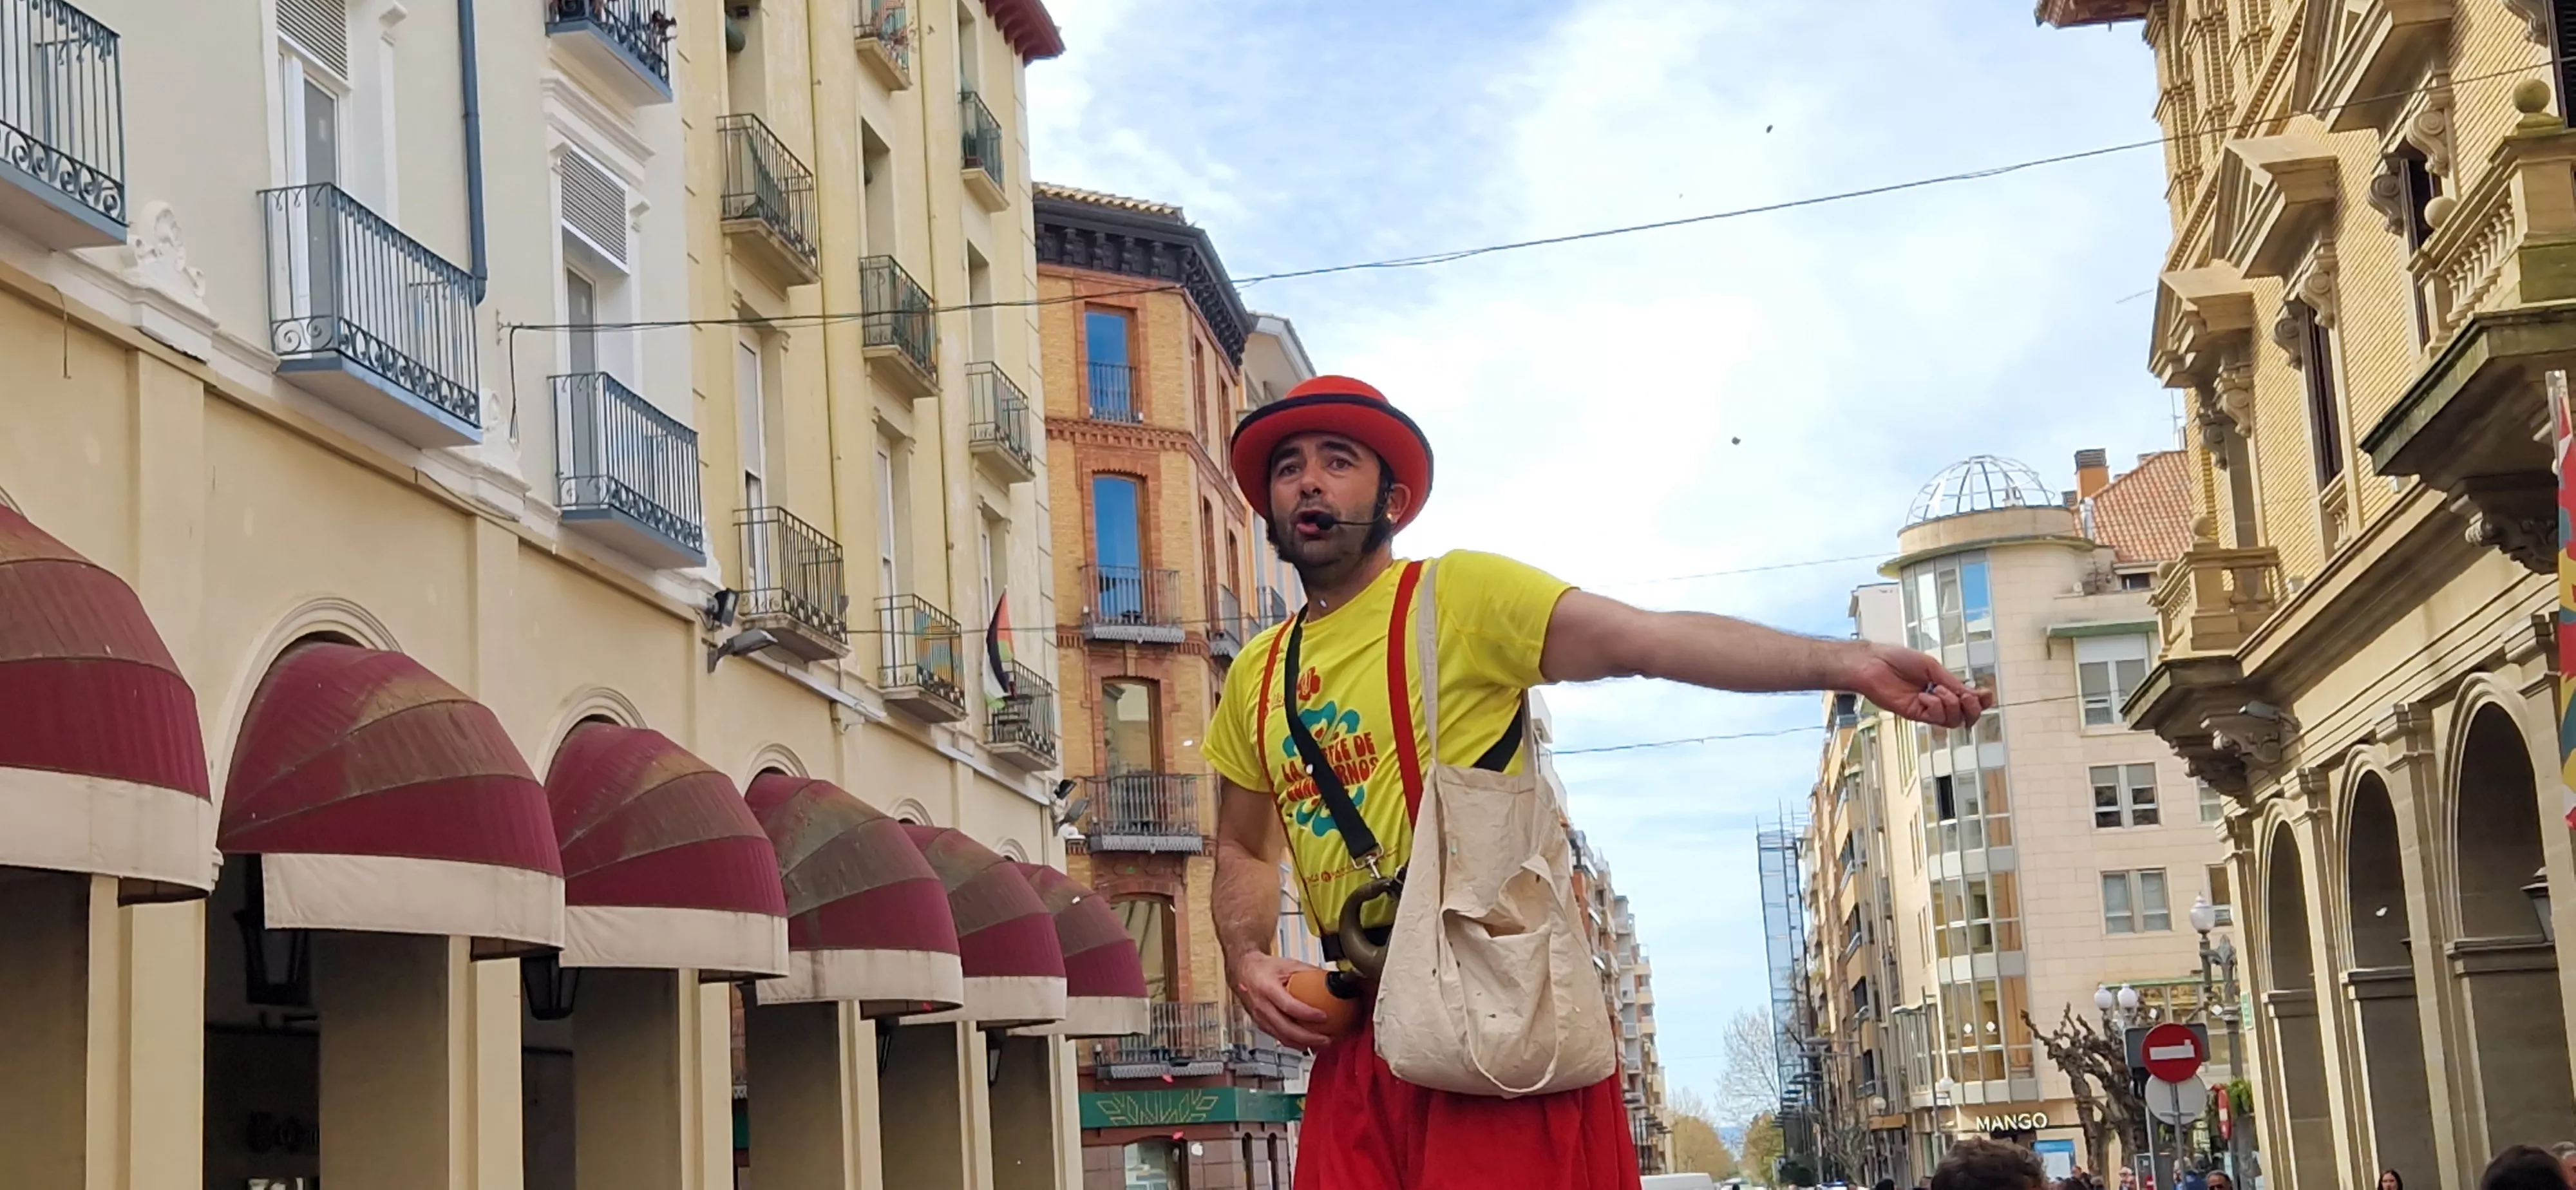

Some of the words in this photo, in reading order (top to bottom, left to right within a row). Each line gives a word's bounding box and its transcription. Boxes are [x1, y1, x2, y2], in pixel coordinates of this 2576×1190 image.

[1281, 760, 1305, 783] LA
[1352, 732, 1376, 757] DE
[1976, 1111, 2048, 1132] MANGO
